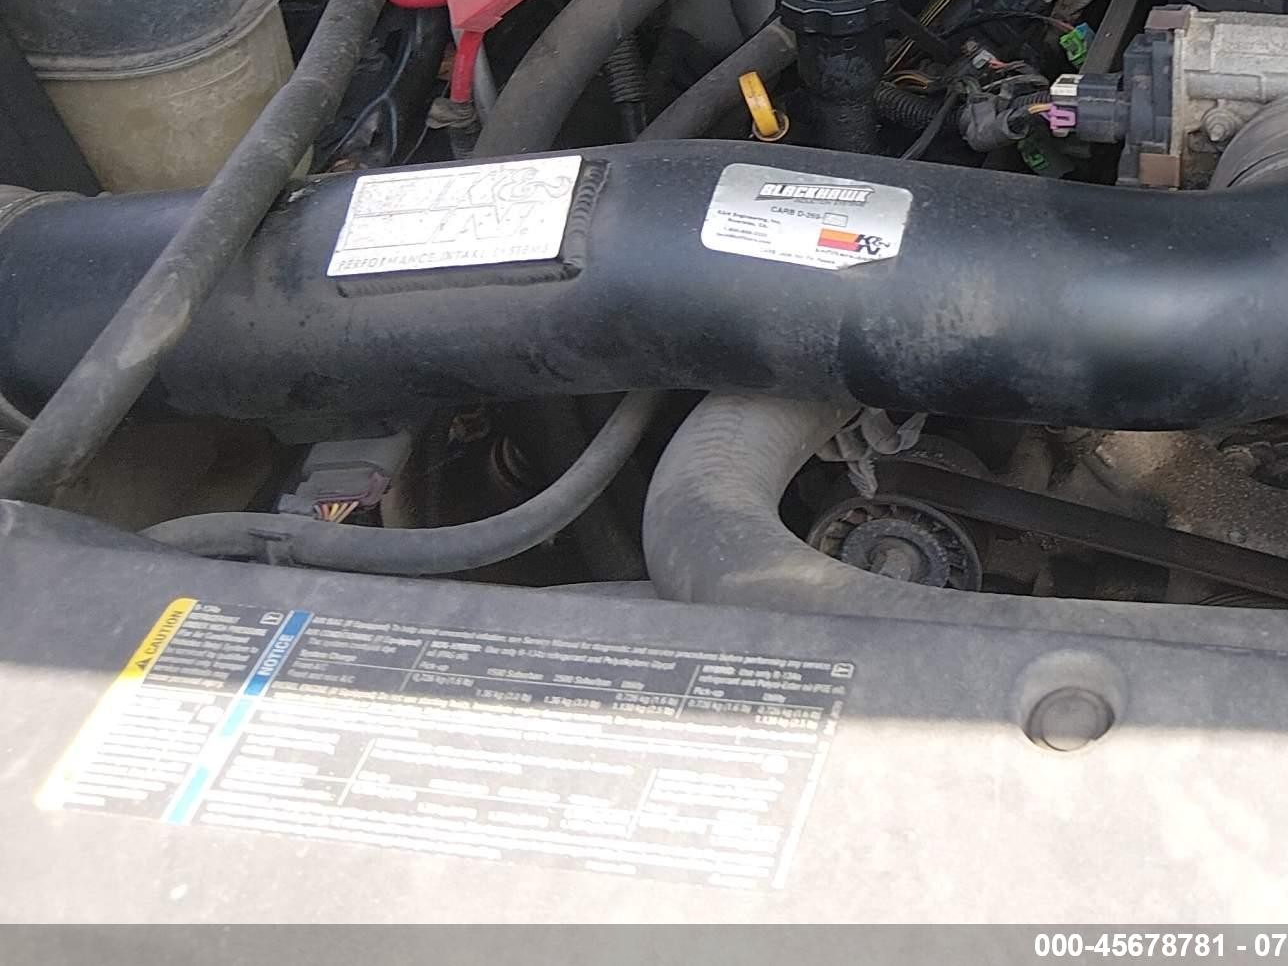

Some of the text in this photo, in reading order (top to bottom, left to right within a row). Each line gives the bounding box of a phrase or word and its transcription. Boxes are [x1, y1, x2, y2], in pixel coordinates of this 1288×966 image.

[759, 183, 870, 203] BLACKHAWK
[770, 205, 795, 216] CARB
[336, 251, 436, 272] PERFORMANCE
[149, 610, 183, 656] CAUTION
[257, 634, 293, 677] NOTICE
